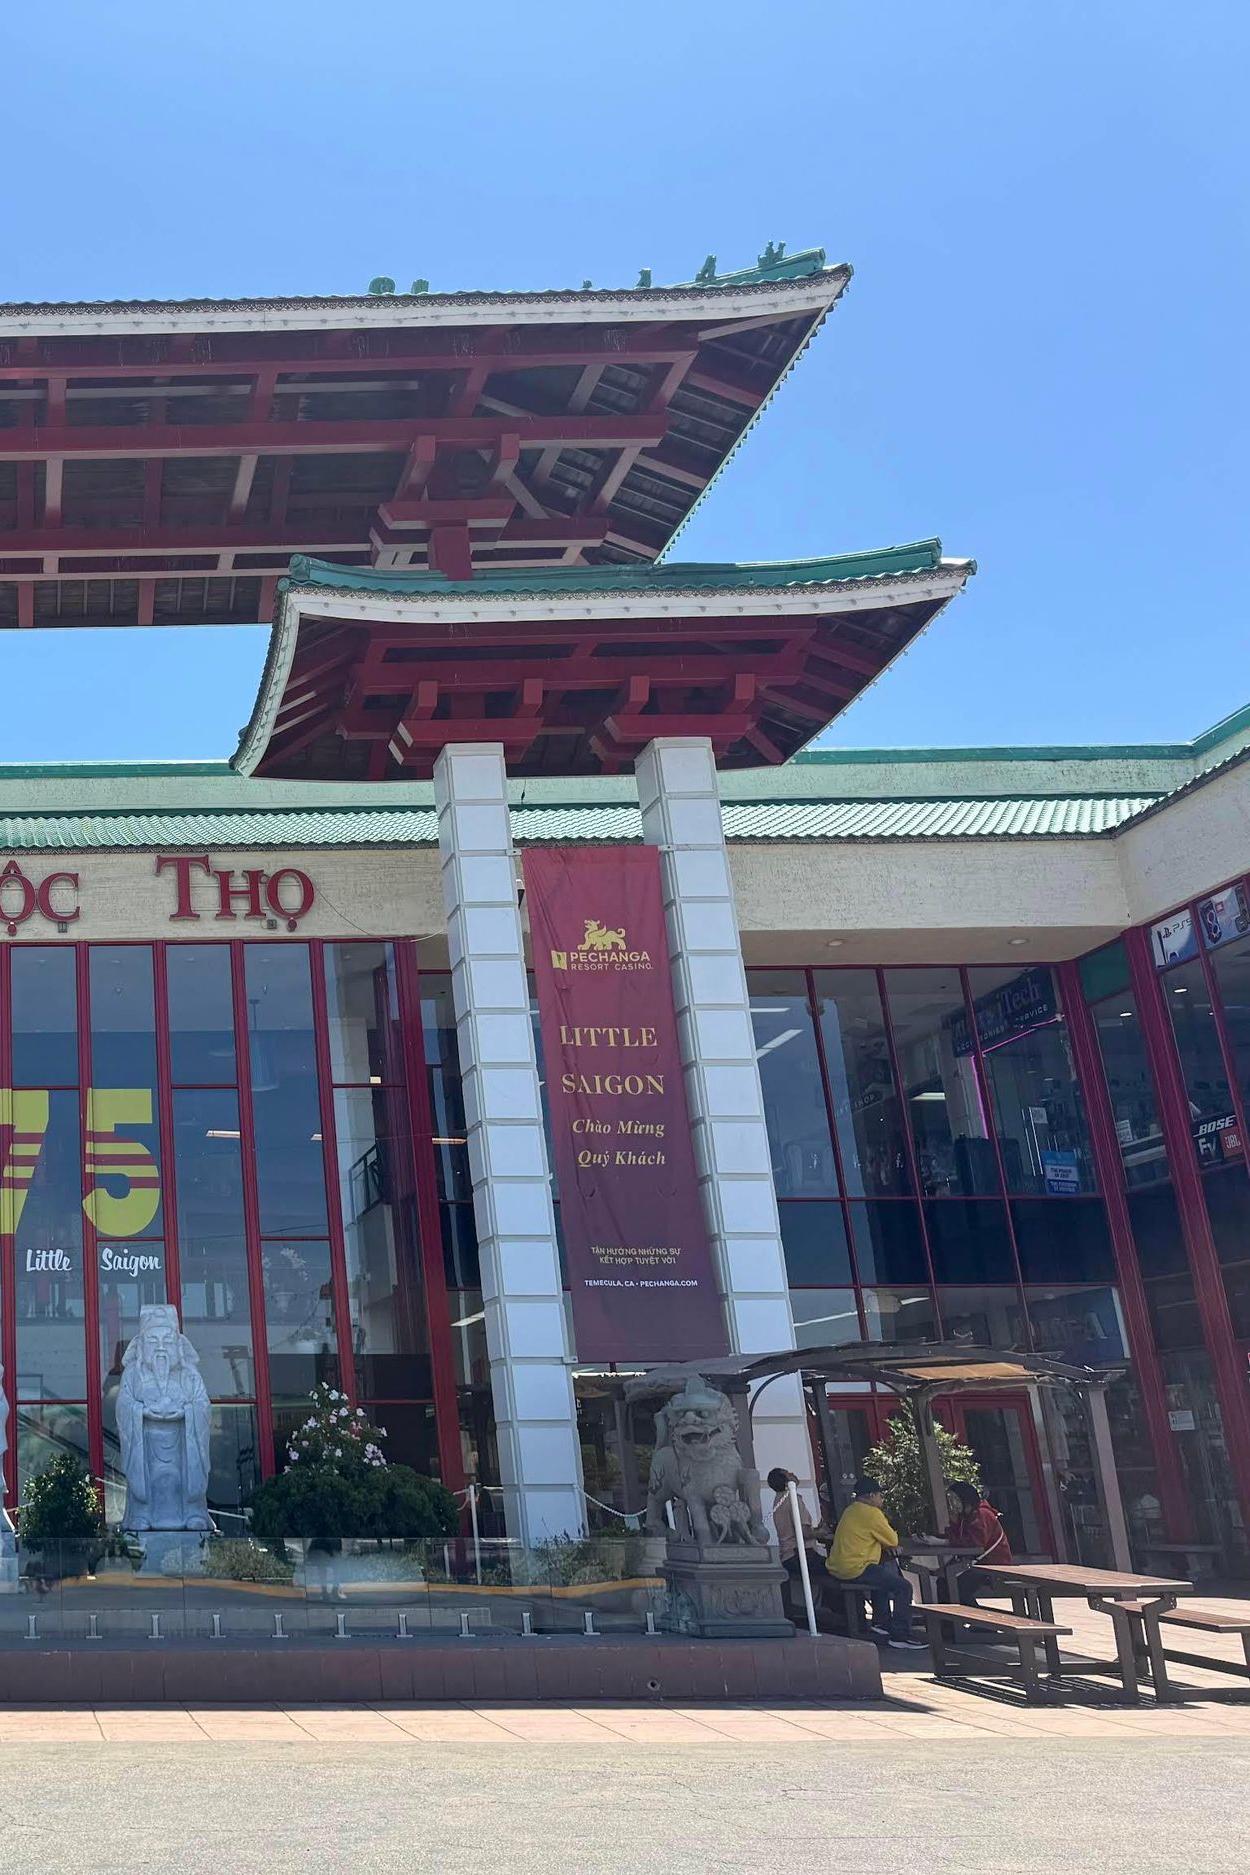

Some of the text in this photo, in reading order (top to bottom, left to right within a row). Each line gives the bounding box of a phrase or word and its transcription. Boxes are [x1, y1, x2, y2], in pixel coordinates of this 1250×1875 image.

[155, 854, 315, 932] THỌ
[570, 951, 651, 962] PECHANGA
[571, 963, 609, 971] RESORT
[560, 1025, 658, 1047] LITTLE
[561, 1073, 665, 1095] SAIGON
[572, 1119, 665, 1137] Chào Mừng
[1193, 1115, 1236, 1138] BOSE
[577, 1150, 666, 1167] Quý Khách
[25, 1248, 162, 1277] Little Saigon
